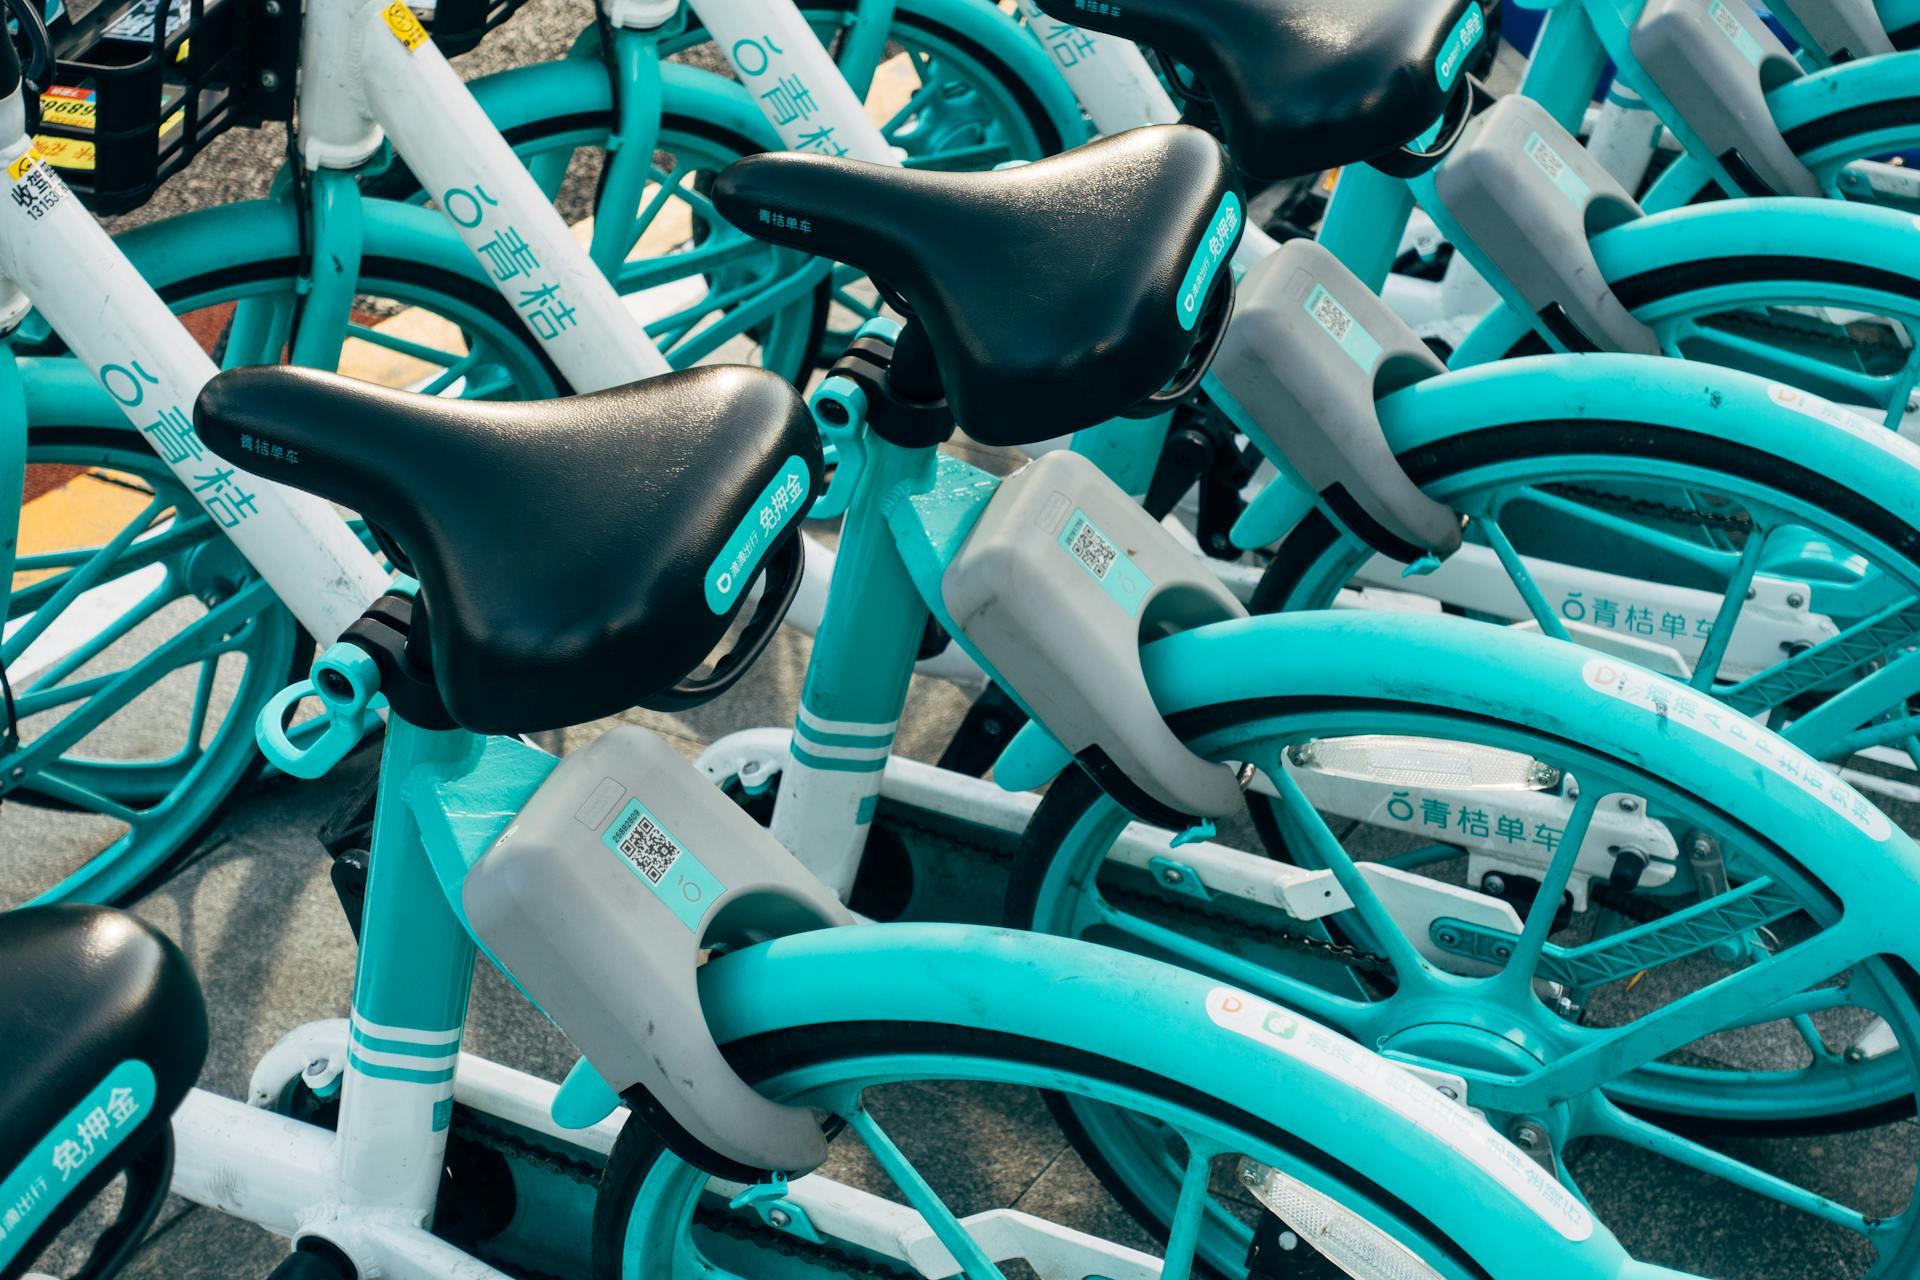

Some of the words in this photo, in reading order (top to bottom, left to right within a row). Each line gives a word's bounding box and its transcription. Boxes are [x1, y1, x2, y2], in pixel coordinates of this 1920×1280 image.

[1209, 207, 1237, 262] 免押金
[478, 226, 577, 340] 青桔
[144, 405, 258, 528] 青桔
[760, 474, 803, 538] 免押金
[1419, 798, 1563, 852] 青桔单车
[53, 1087, 139, 1182] 免押金
